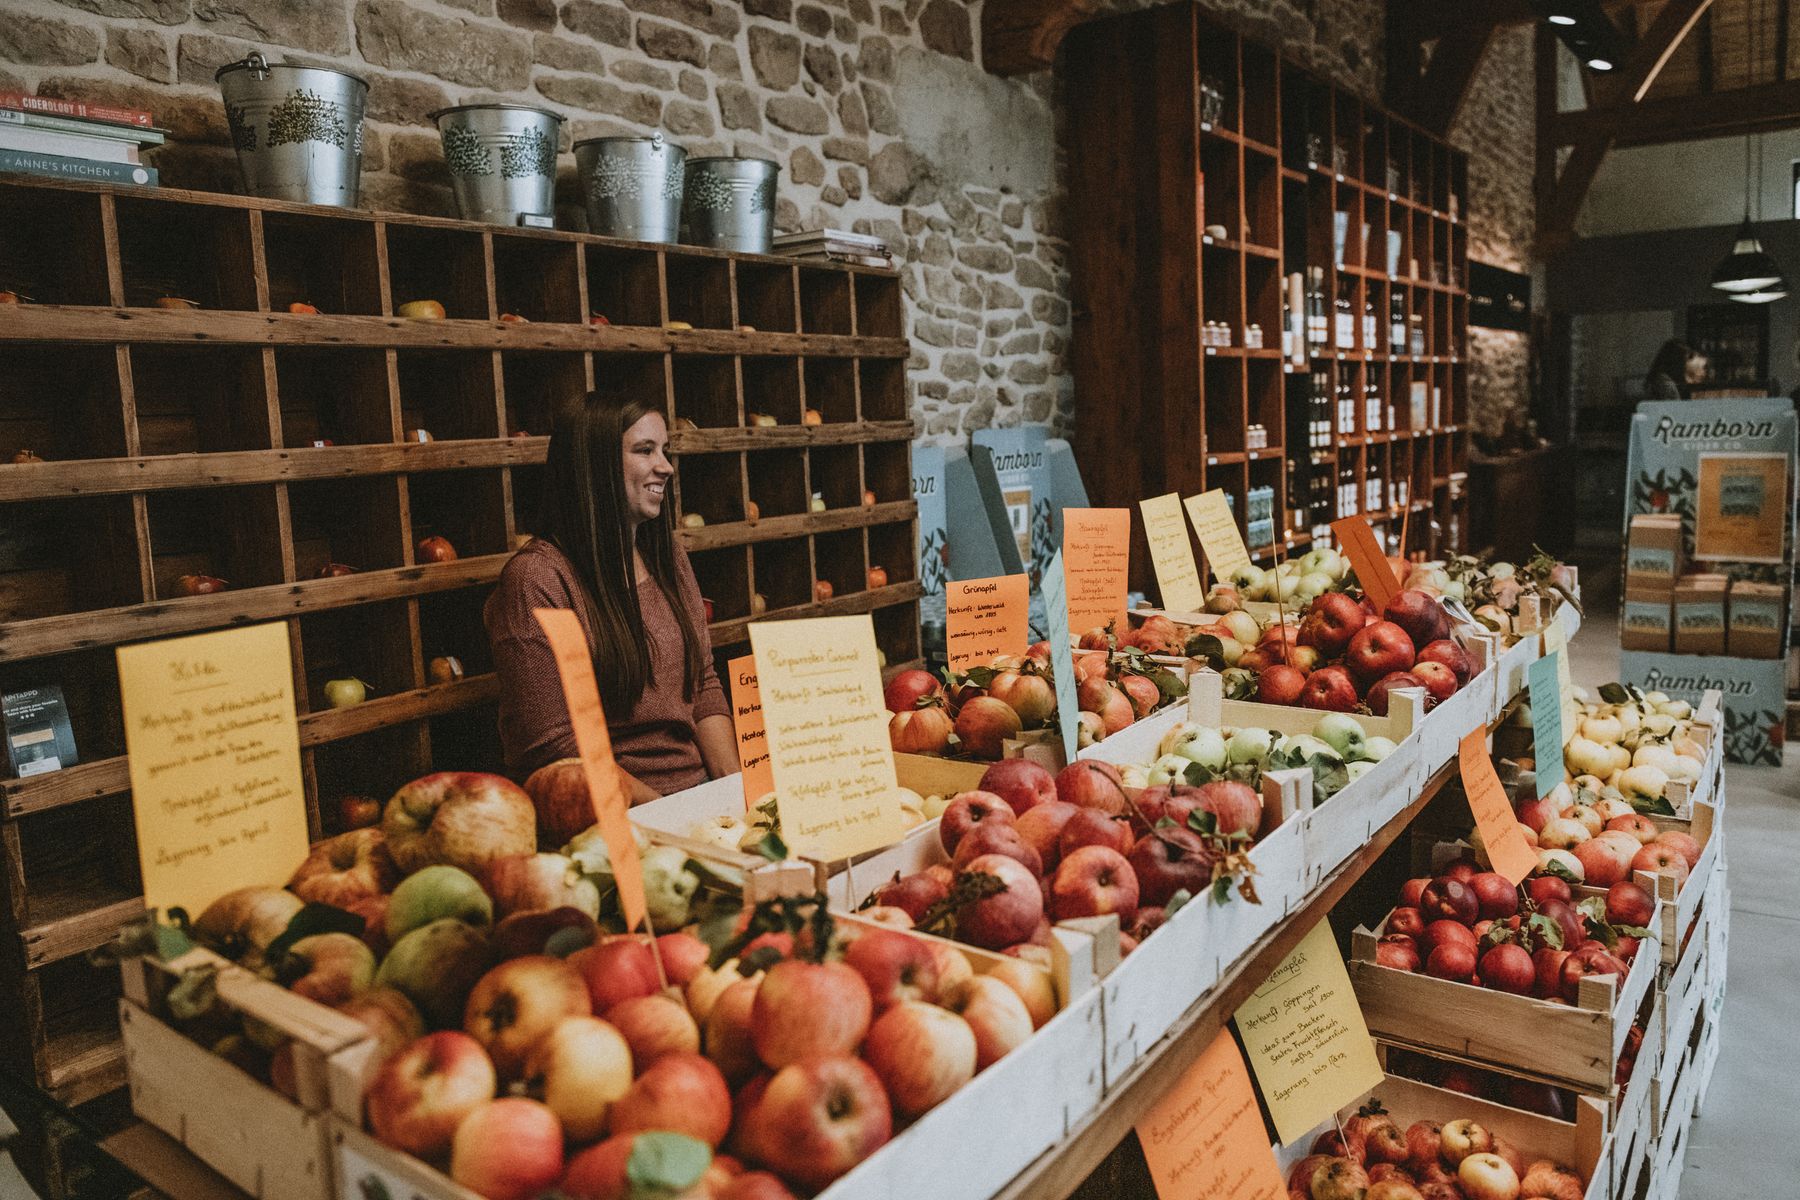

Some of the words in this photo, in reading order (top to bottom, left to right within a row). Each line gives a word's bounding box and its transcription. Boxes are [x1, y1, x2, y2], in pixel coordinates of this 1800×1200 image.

[22, 97, 74, 114] CIDEROLOGY
[15, 158, 58, 171] ANNE'S
[62, 163, 111, 177] KITCHEN
[1654, 415, 1773, 445] Ramborn
[989, 447, 1043, 472] amborn
[963, 583, 997, 595] Grünapfel
[1644, 667, 1756, 695] Ramborn
[4, 690, 38, 701] UNTAPPD
[1282, 983, 1321, 1015] Göppingen
[1281, 1029, 1297, 1043] zum
[1296, 1012, 1326, 1034] Backen
[1292, 1019, 1339, 1050] Fruchtfleisch
[1313, 1063, 1328, 1076] bis
